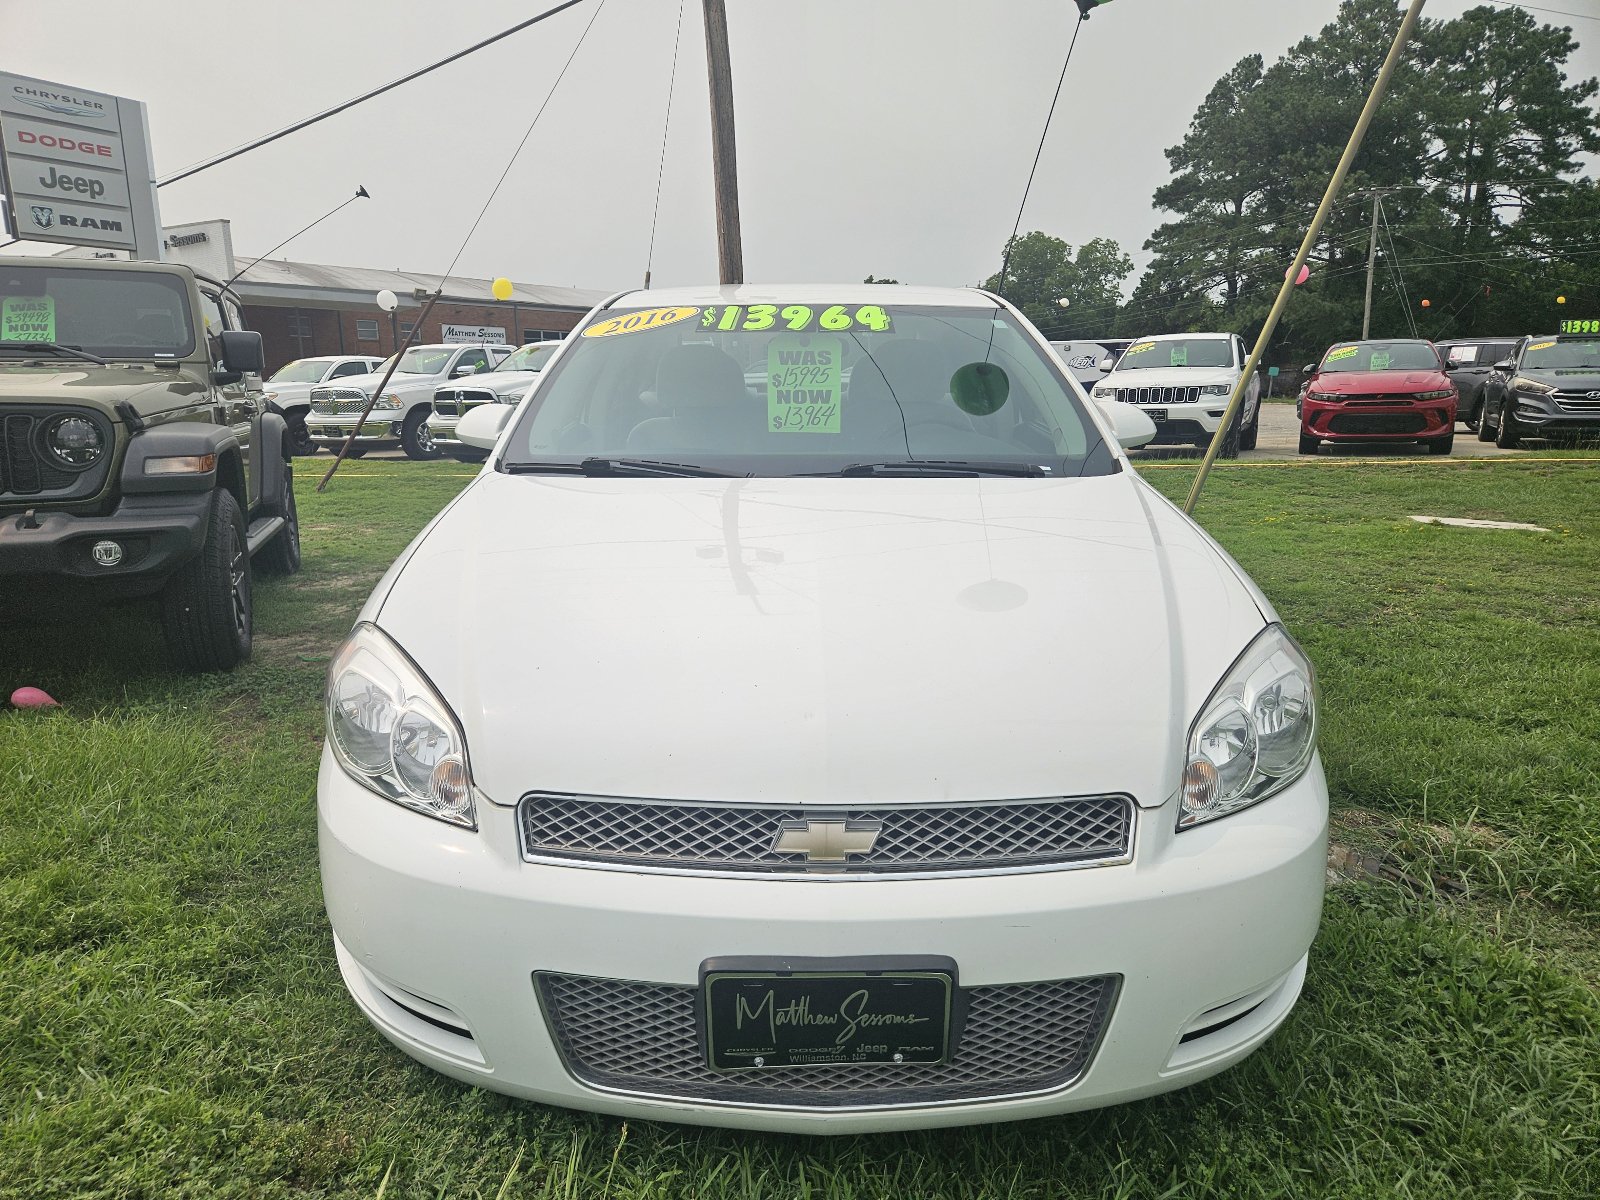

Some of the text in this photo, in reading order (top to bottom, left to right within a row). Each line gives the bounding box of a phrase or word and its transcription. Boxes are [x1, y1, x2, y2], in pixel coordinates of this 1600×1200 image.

[14, 86, 104, 110] CHRYSLER
[17, 130, 113, 157] DODGE
[39, 167, 105, 199] Jeep
[59, 214, 123, 232] RAM
[10, 303, 48, 312] WAS
[603, 308, 678, 335] 2016
[702, 305, 891, 331] $13964
[8, 323, 49, 332] NOW
[778, 350, 832, 365] WAS
[776, 389, 833, 405] NOW
[736, 989, 930, 1044] Matthew Sessoms
[852, 1053, 867, 1061] NC
[856, 1043, 888, 1054] Jeep
